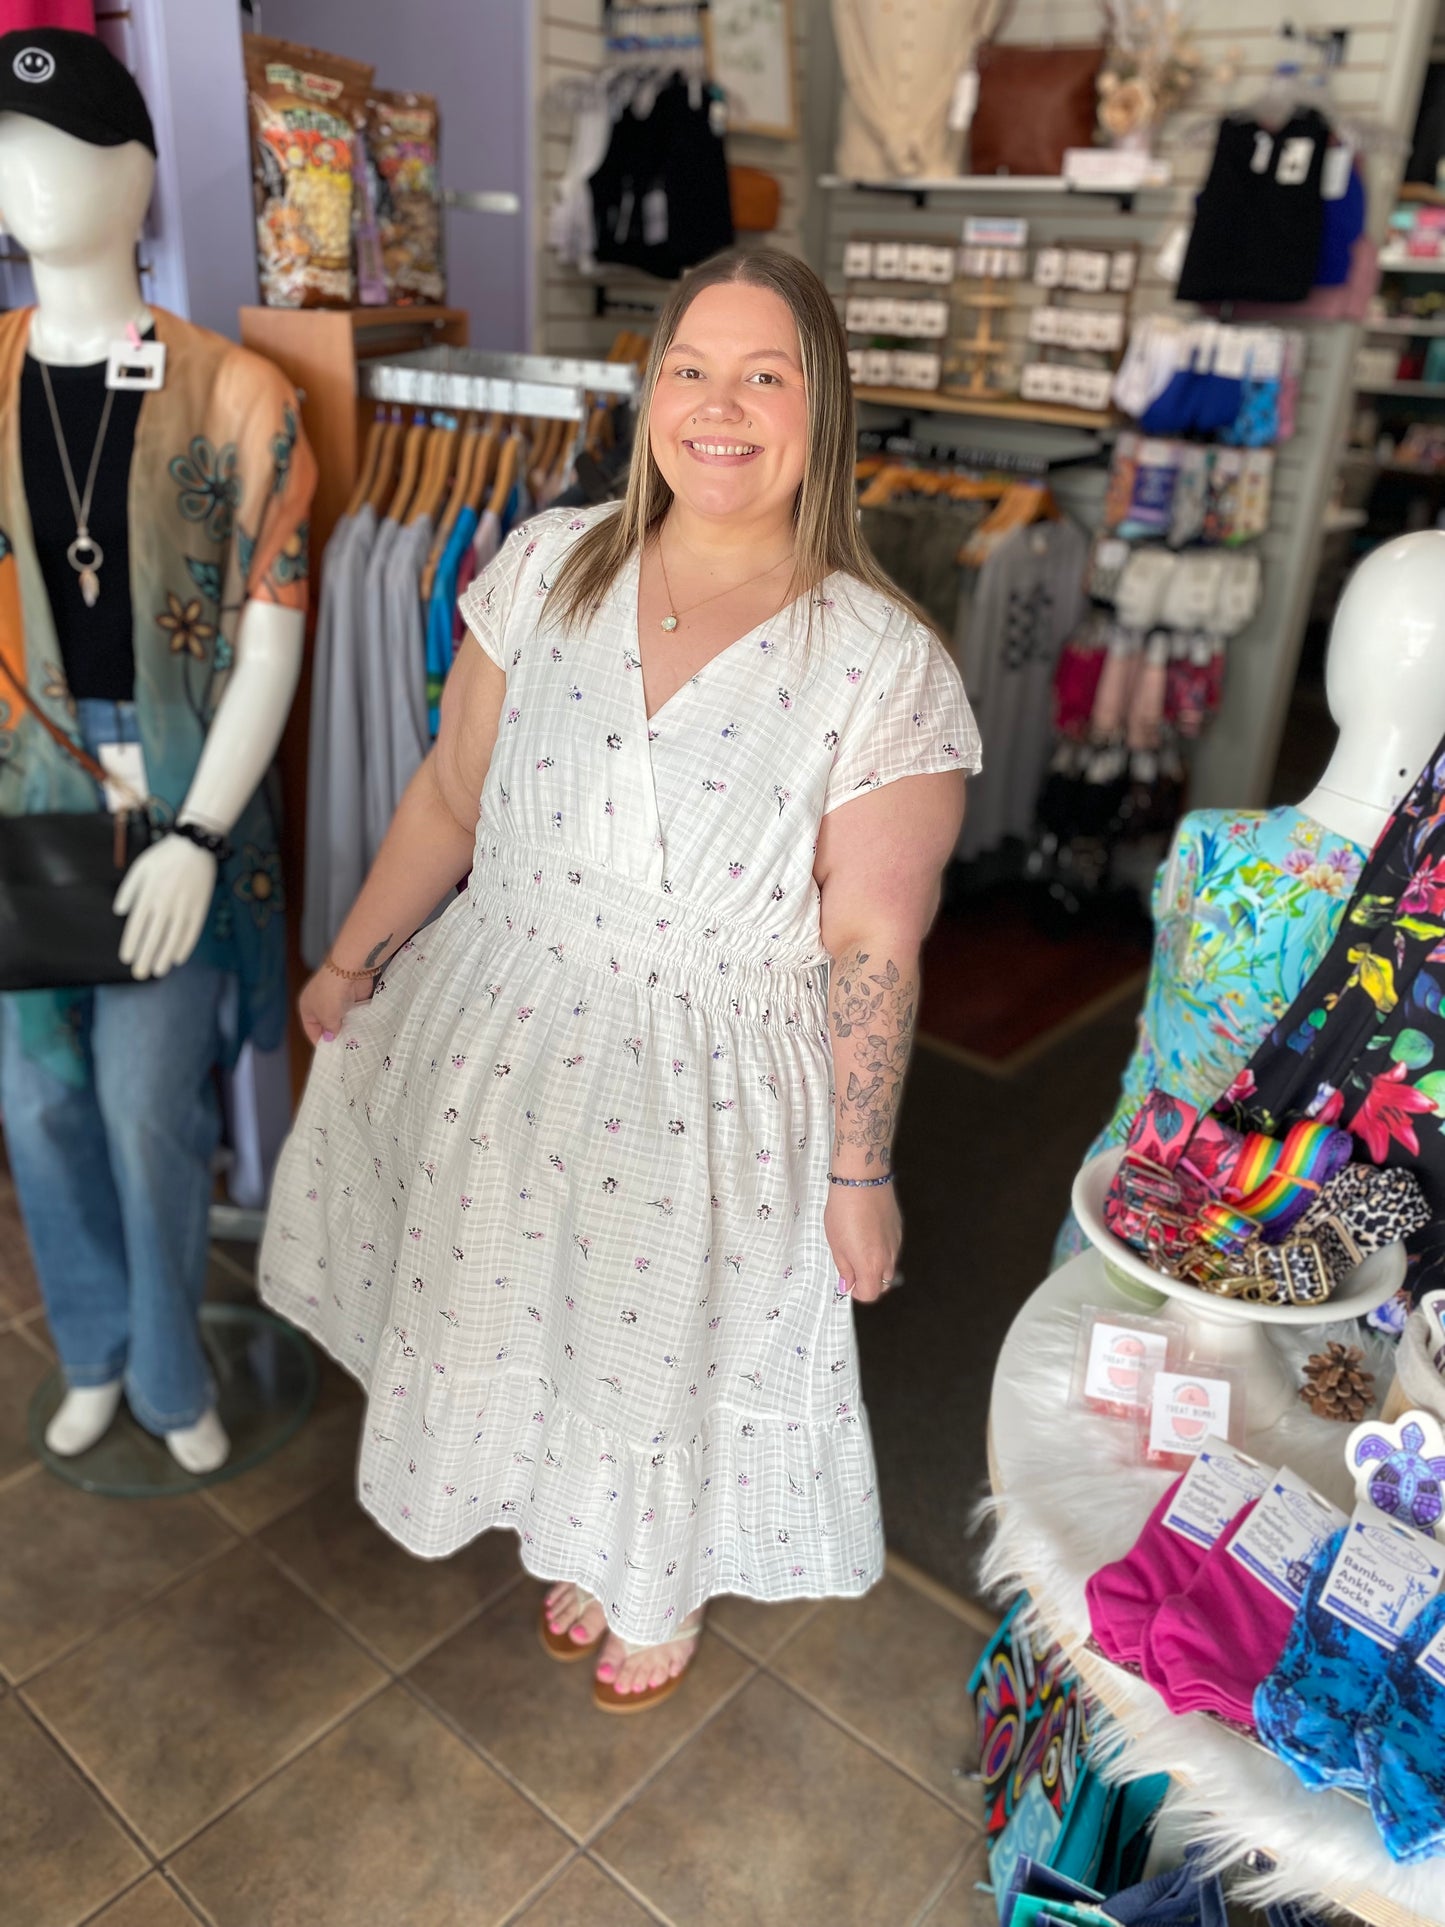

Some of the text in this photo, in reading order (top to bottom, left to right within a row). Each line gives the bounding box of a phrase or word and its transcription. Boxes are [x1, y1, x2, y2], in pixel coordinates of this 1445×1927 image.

[1165, 1403, 1190, 1415] TREAT
[1338, 1568, 1376, 1597] Ankle
[1343, 1554, 1396, 1593] Bamboo
[1333, 1578, 1371, 1609] Socks
